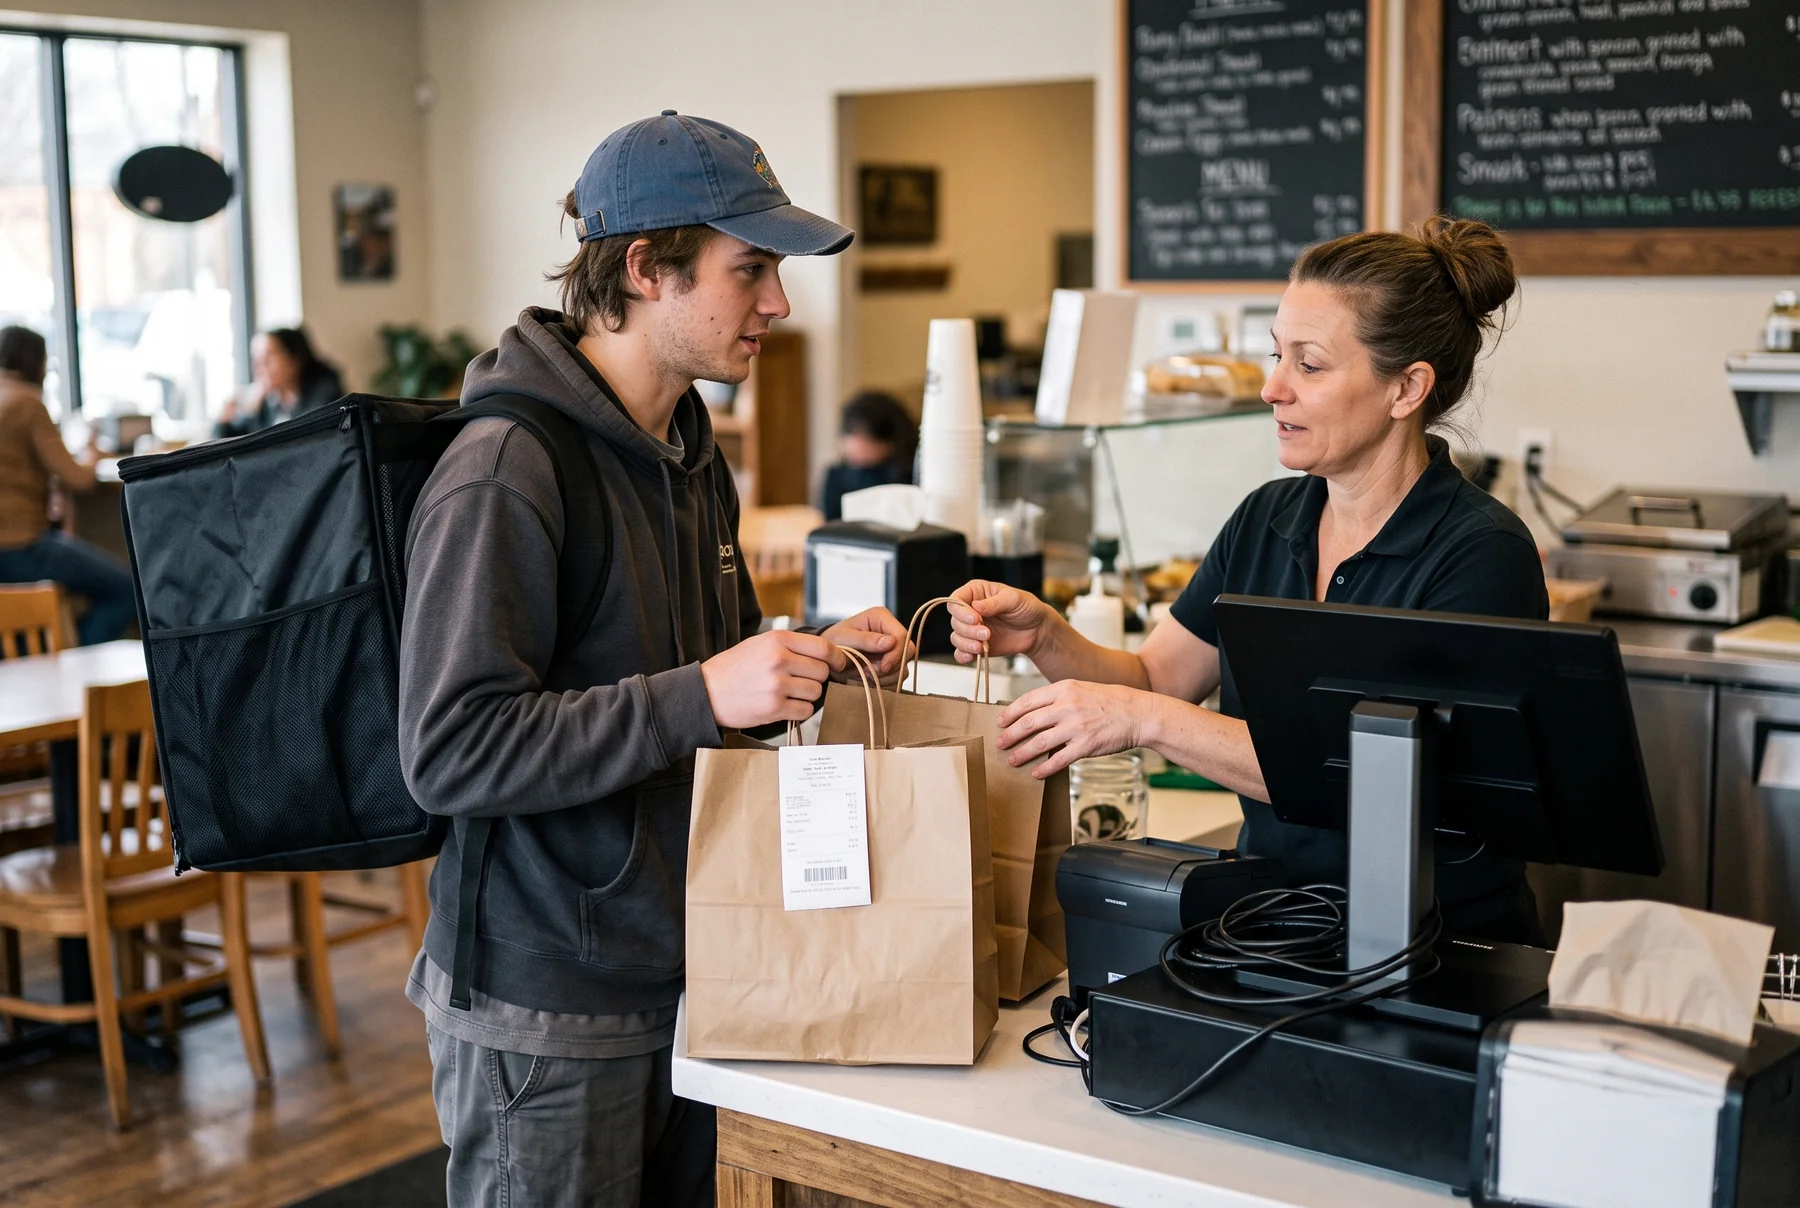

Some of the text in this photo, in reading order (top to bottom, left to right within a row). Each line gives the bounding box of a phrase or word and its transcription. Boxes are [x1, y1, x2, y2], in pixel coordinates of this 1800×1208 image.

[1706, 25, 1746, 48] with
[1710, 98, 1752, 121] with
[1201, 159, 1268, 190] MENU
